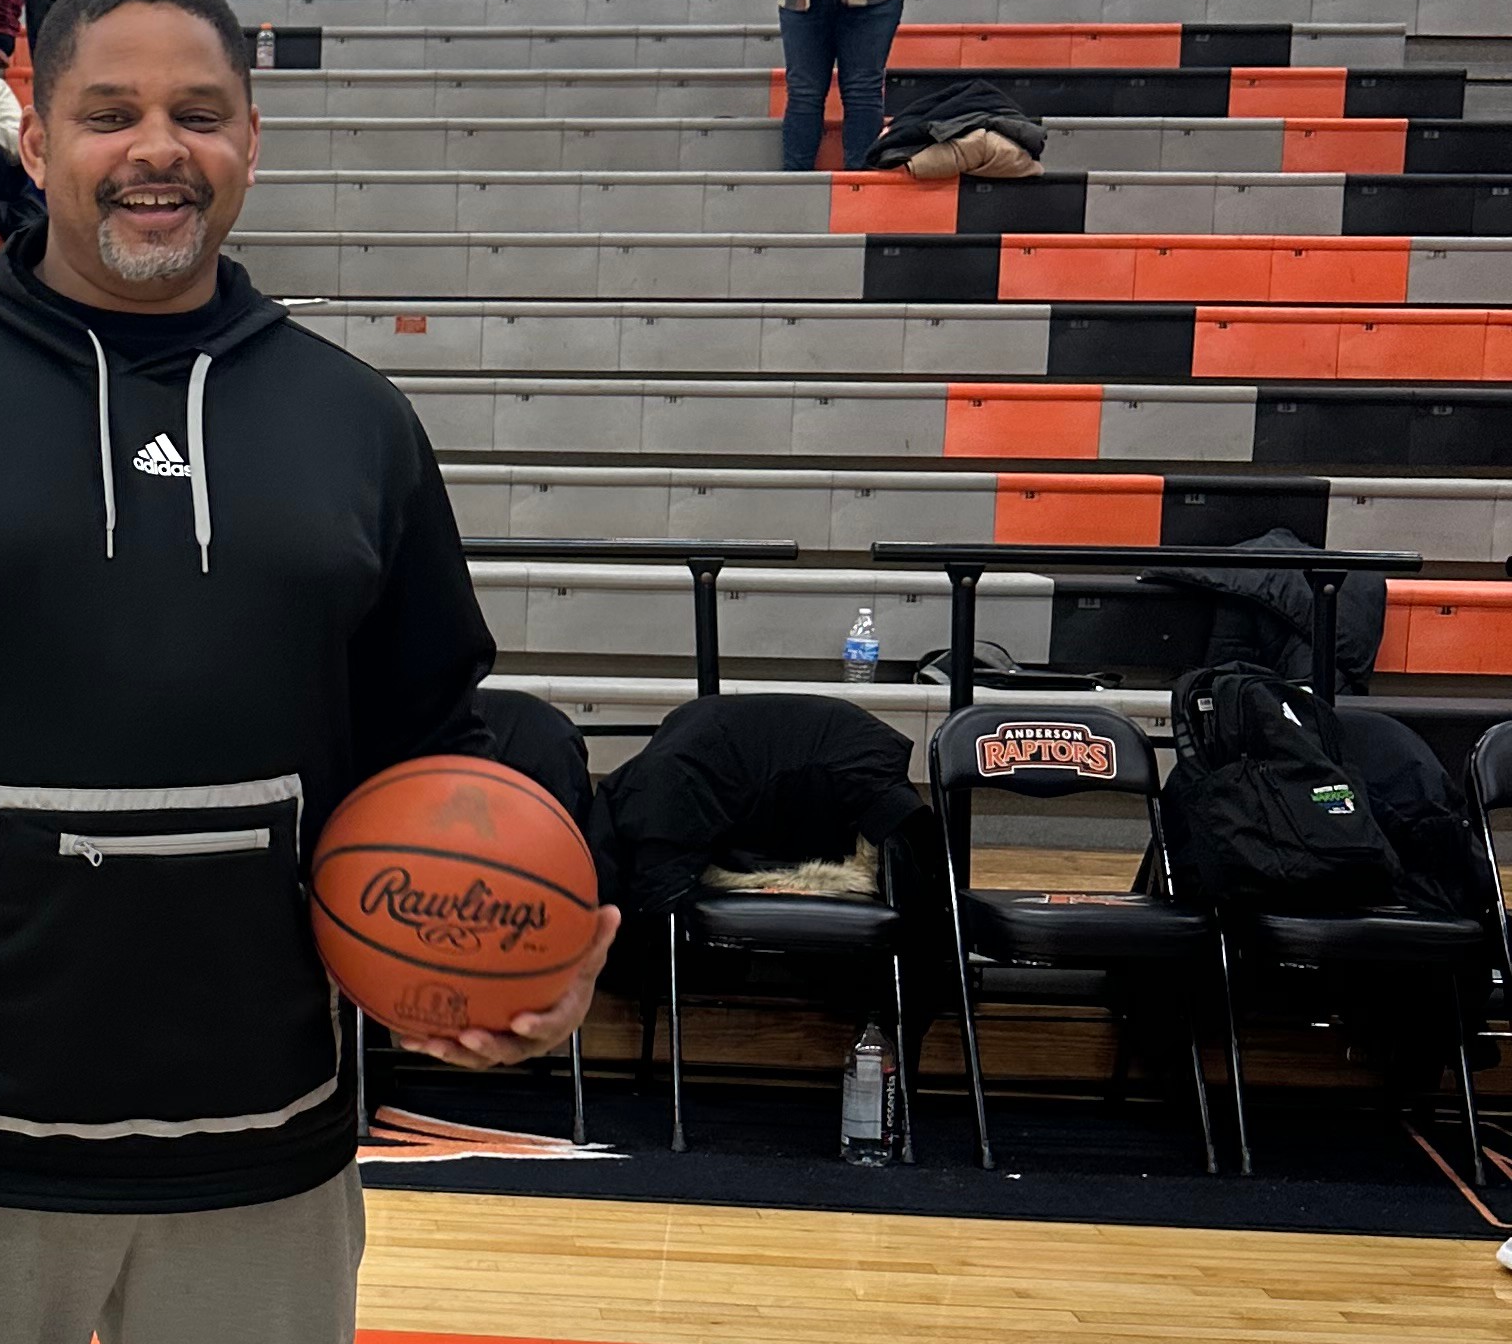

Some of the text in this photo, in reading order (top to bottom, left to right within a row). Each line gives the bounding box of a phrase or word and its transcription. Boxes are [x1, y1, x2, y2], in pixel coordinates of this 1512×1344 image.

[133, 458, 192, 477] adidas
[1005, 728, 1083, 741] ANDERSON
[984, 740, 1108, 771] RAPTORS
[360, 866, 549, 952] Rawlings
